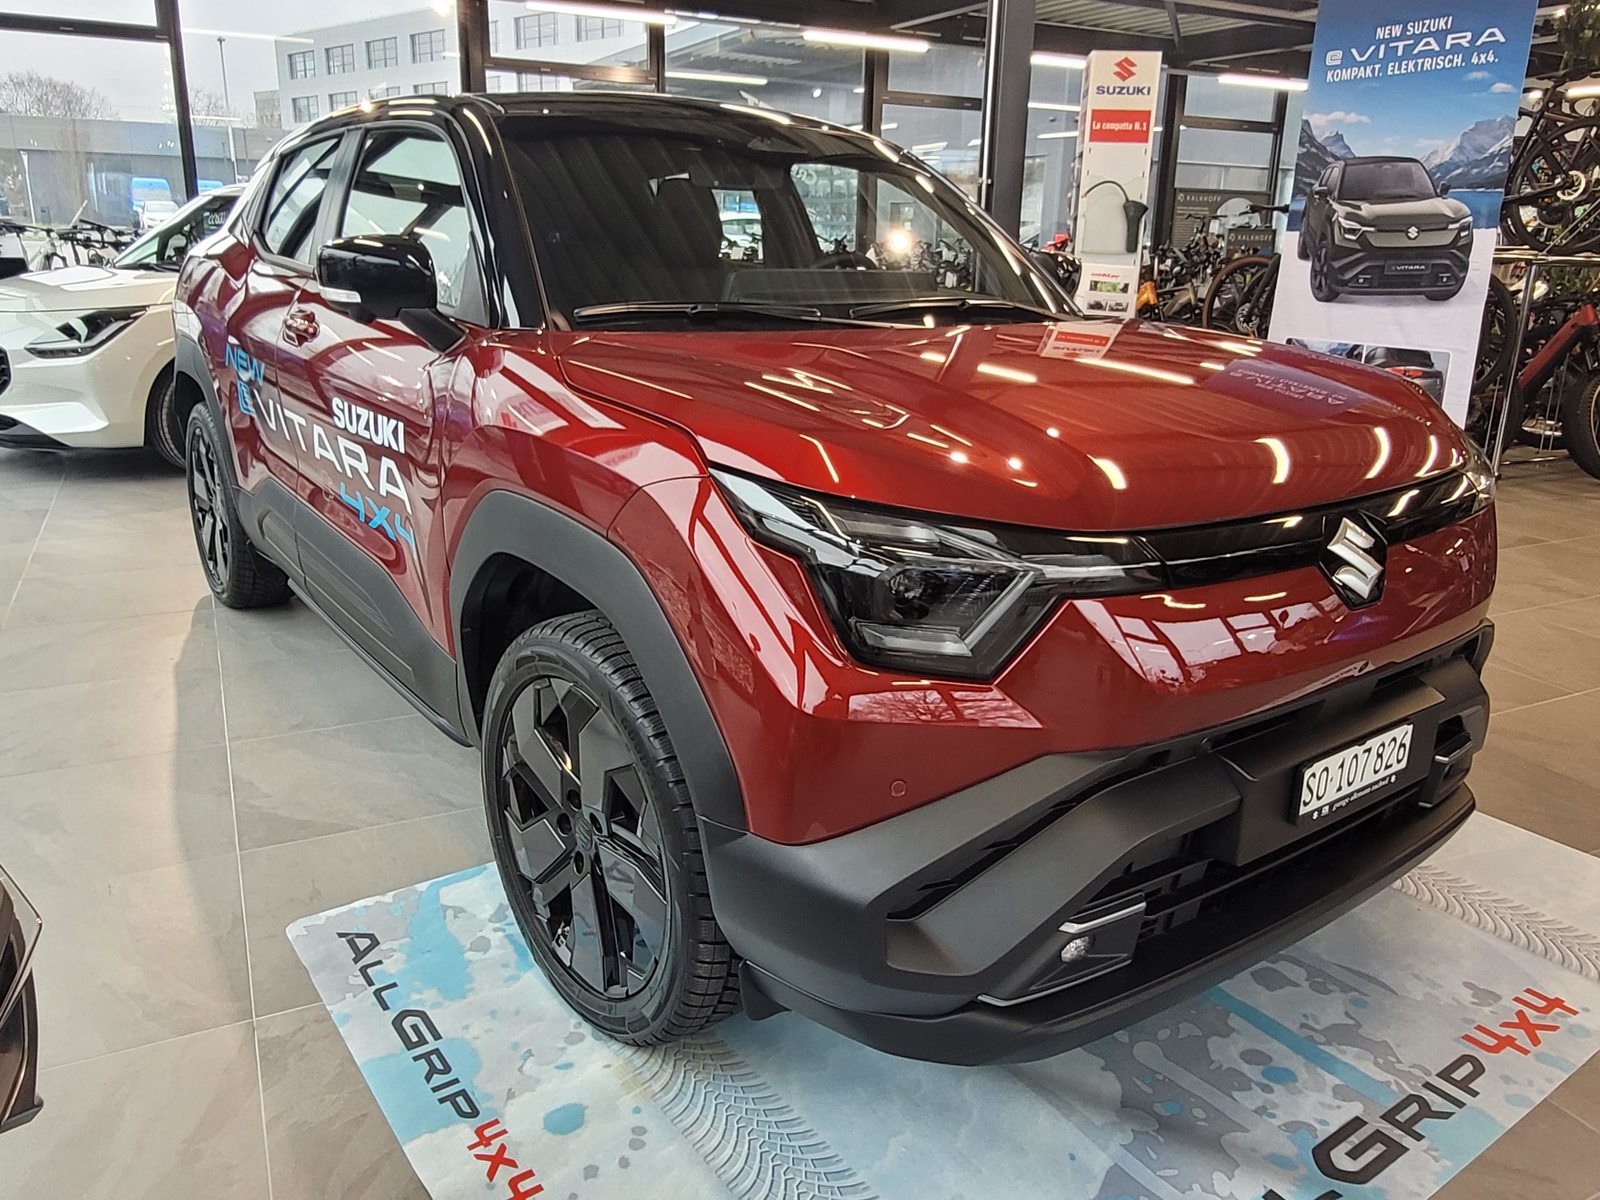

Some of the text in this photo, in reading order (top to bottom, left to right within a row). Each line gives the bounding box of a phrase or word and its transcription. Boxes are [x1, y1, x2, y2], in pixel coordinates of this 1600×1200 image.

[1351, 27, 1506, 63] VITARA
[1376, 16, 1453, 40] NEW SUZUKI
[1326, 50, 1499, 83] KOMPAKT. ELEKTRISCH. 4x4.
[1095, 85, 1151, 96] SUZUKI
[1092, 121, 1101, 130] La
[225, 343, 405, 454] NEW SUZUKI
[253, 388, 412, 516] VITARA
[335, 931, 481, 1119] ALLGRIP
